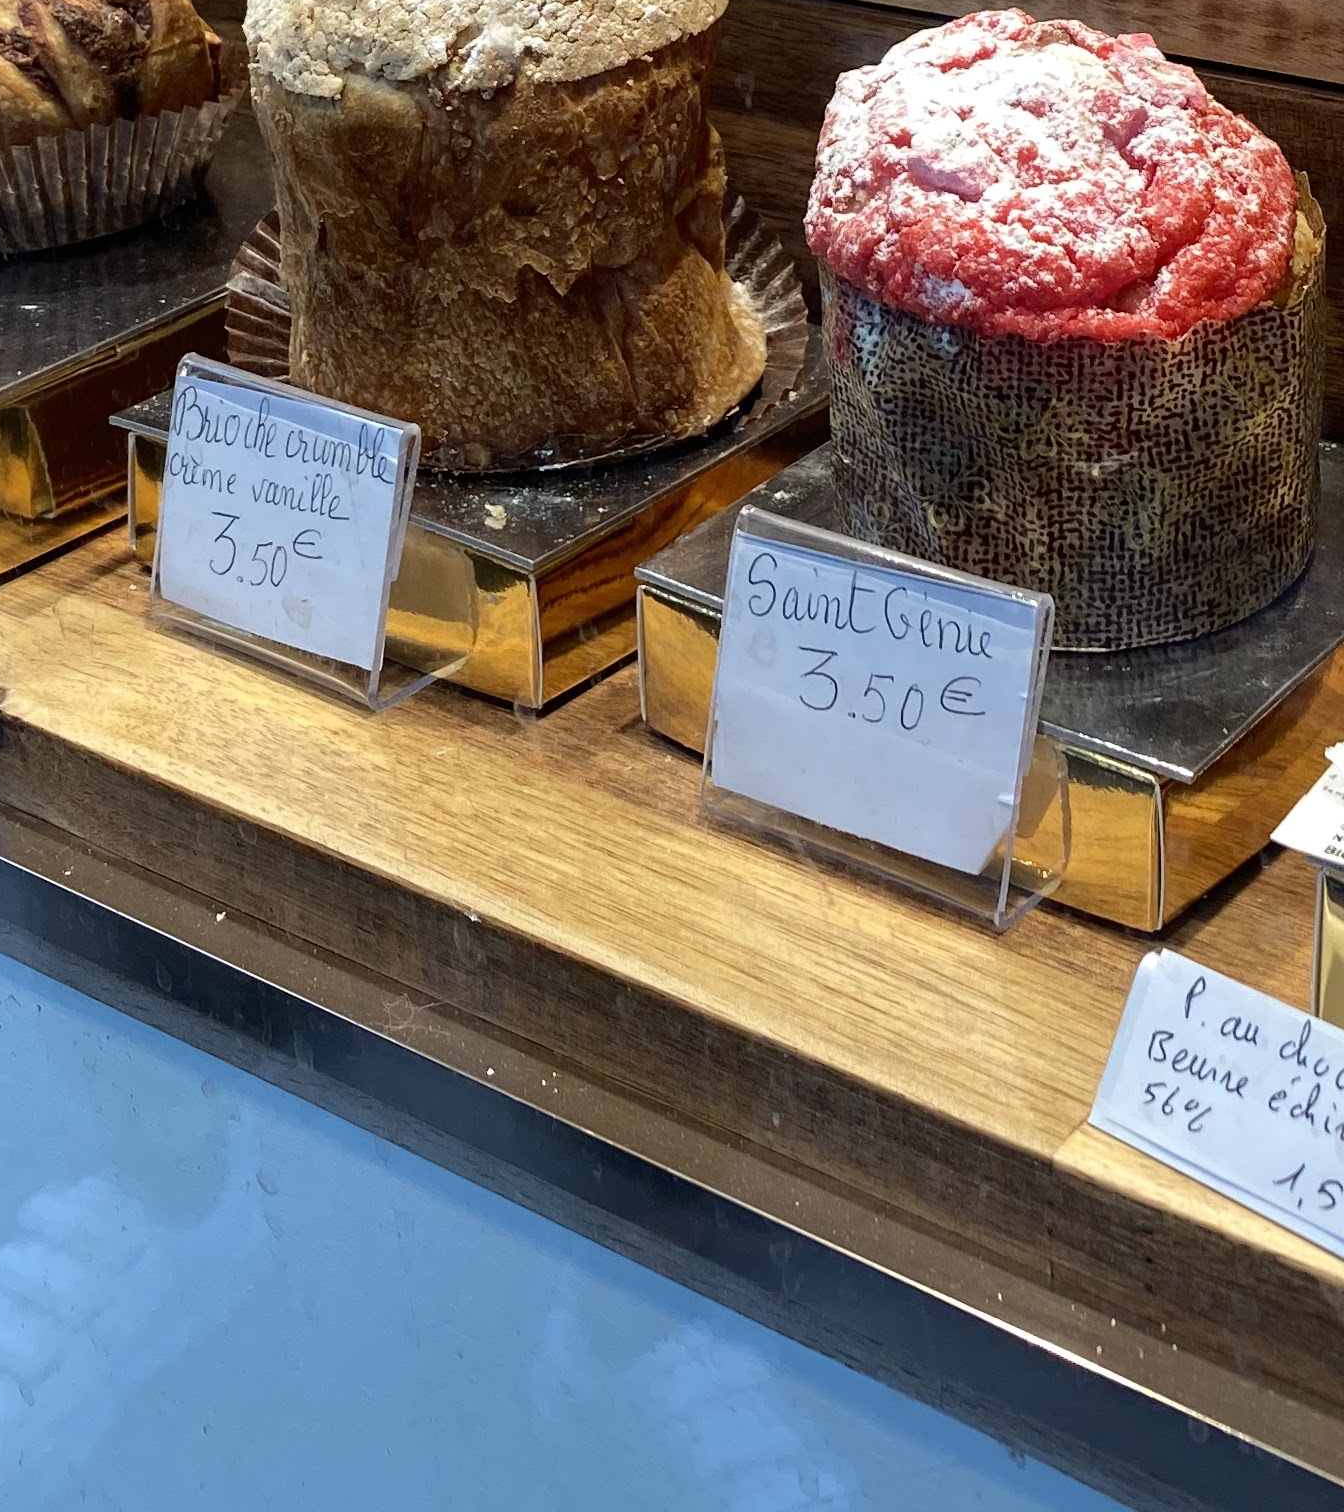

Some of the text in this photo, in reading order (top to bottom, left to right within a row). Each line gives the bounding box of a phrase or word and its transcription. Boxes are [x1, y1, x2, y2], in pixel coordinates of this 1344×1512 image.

[173, 386, 394, 484] Brioche crumble
[169, 452, 349, 522] crème vanille
[748, 552, 876, 634] Saint
[1219, 1014, 1260, 1048] au
